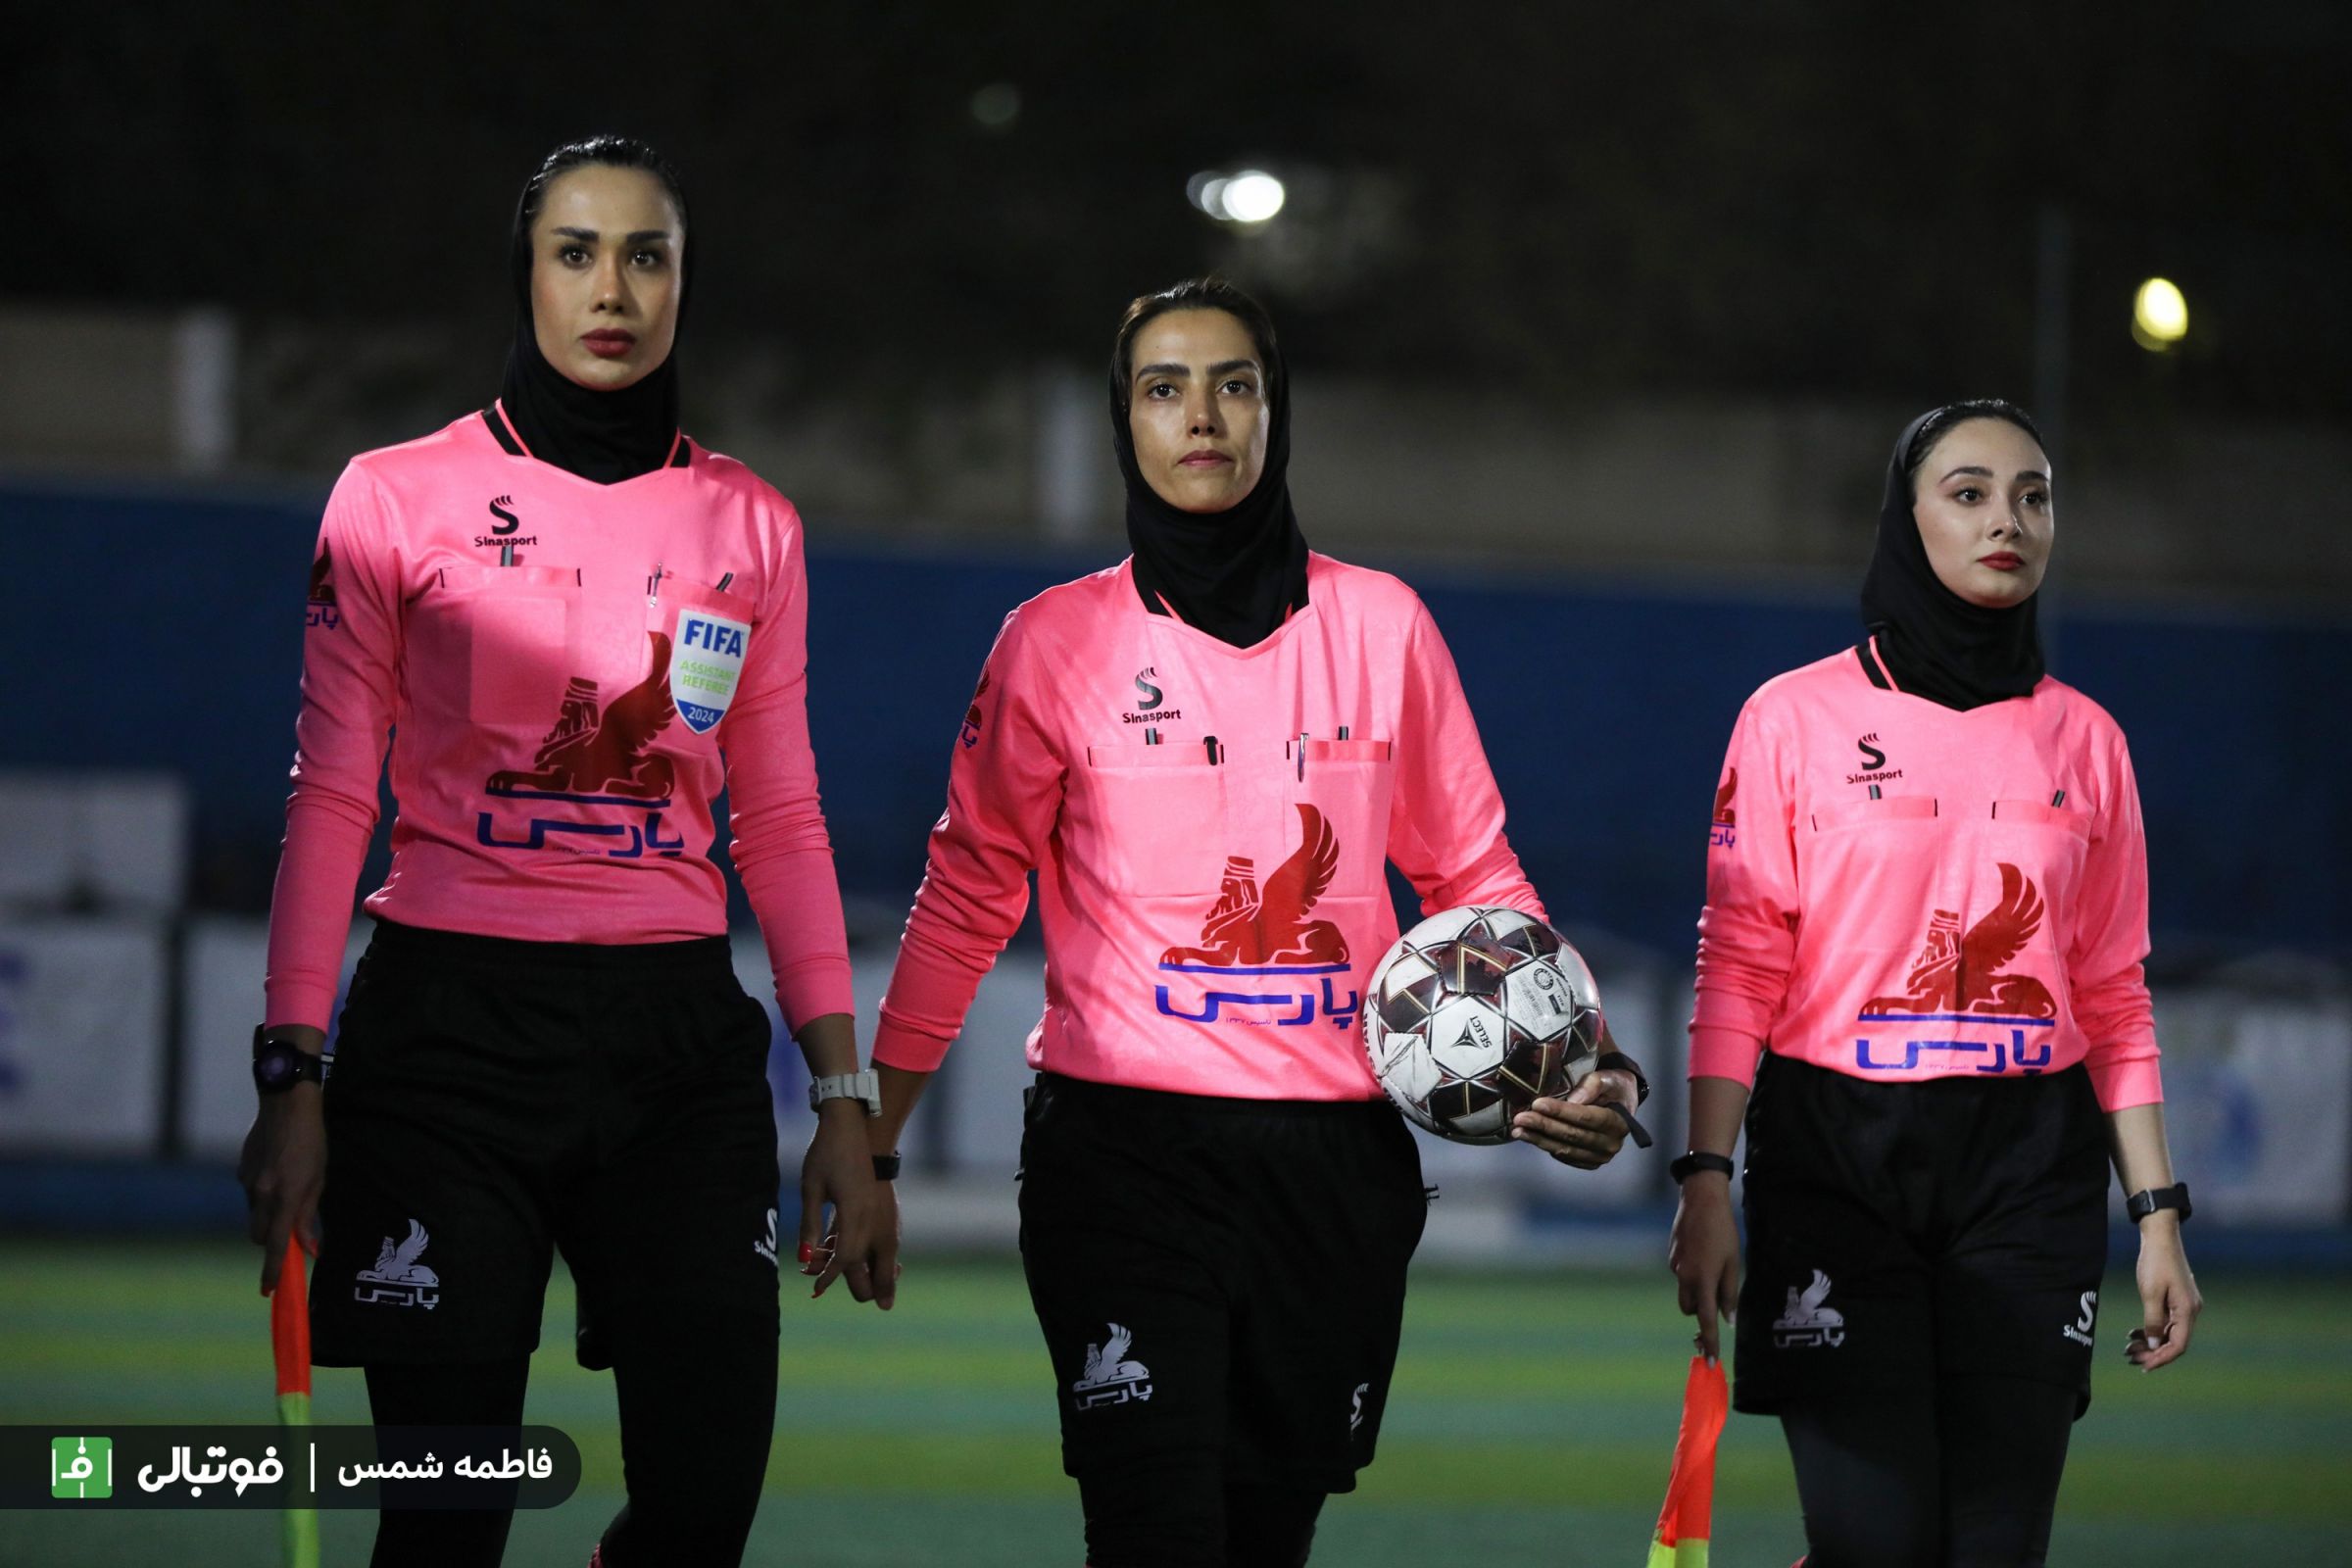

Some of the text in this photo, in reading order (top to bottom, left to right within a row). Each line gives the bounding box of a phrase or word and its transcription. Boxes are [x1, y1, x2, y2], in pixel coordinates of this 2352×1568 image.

[474, 536, 537, 549] Sinasport
[306, 607, 338, 630] پار
[684, 618, 741, 658] FIFA
[680, 660, 736, 682] ASSISTANT
[682, 673, 730, 696] REFEREE
[688, 707, 714, 723] 2024
[1122, 710, 1181, 724] Sinasport
[1846, 769, 1902, 784] Sinasport
[477, 812, 684, 858] پارس
[1154, 977, 1358, 1030] پارس
[1469, 1015, 1493, 1049] SELECT
[1856, 1030, 2051, 1078] پارس
[355, 1287, 439, 1310] پارس
